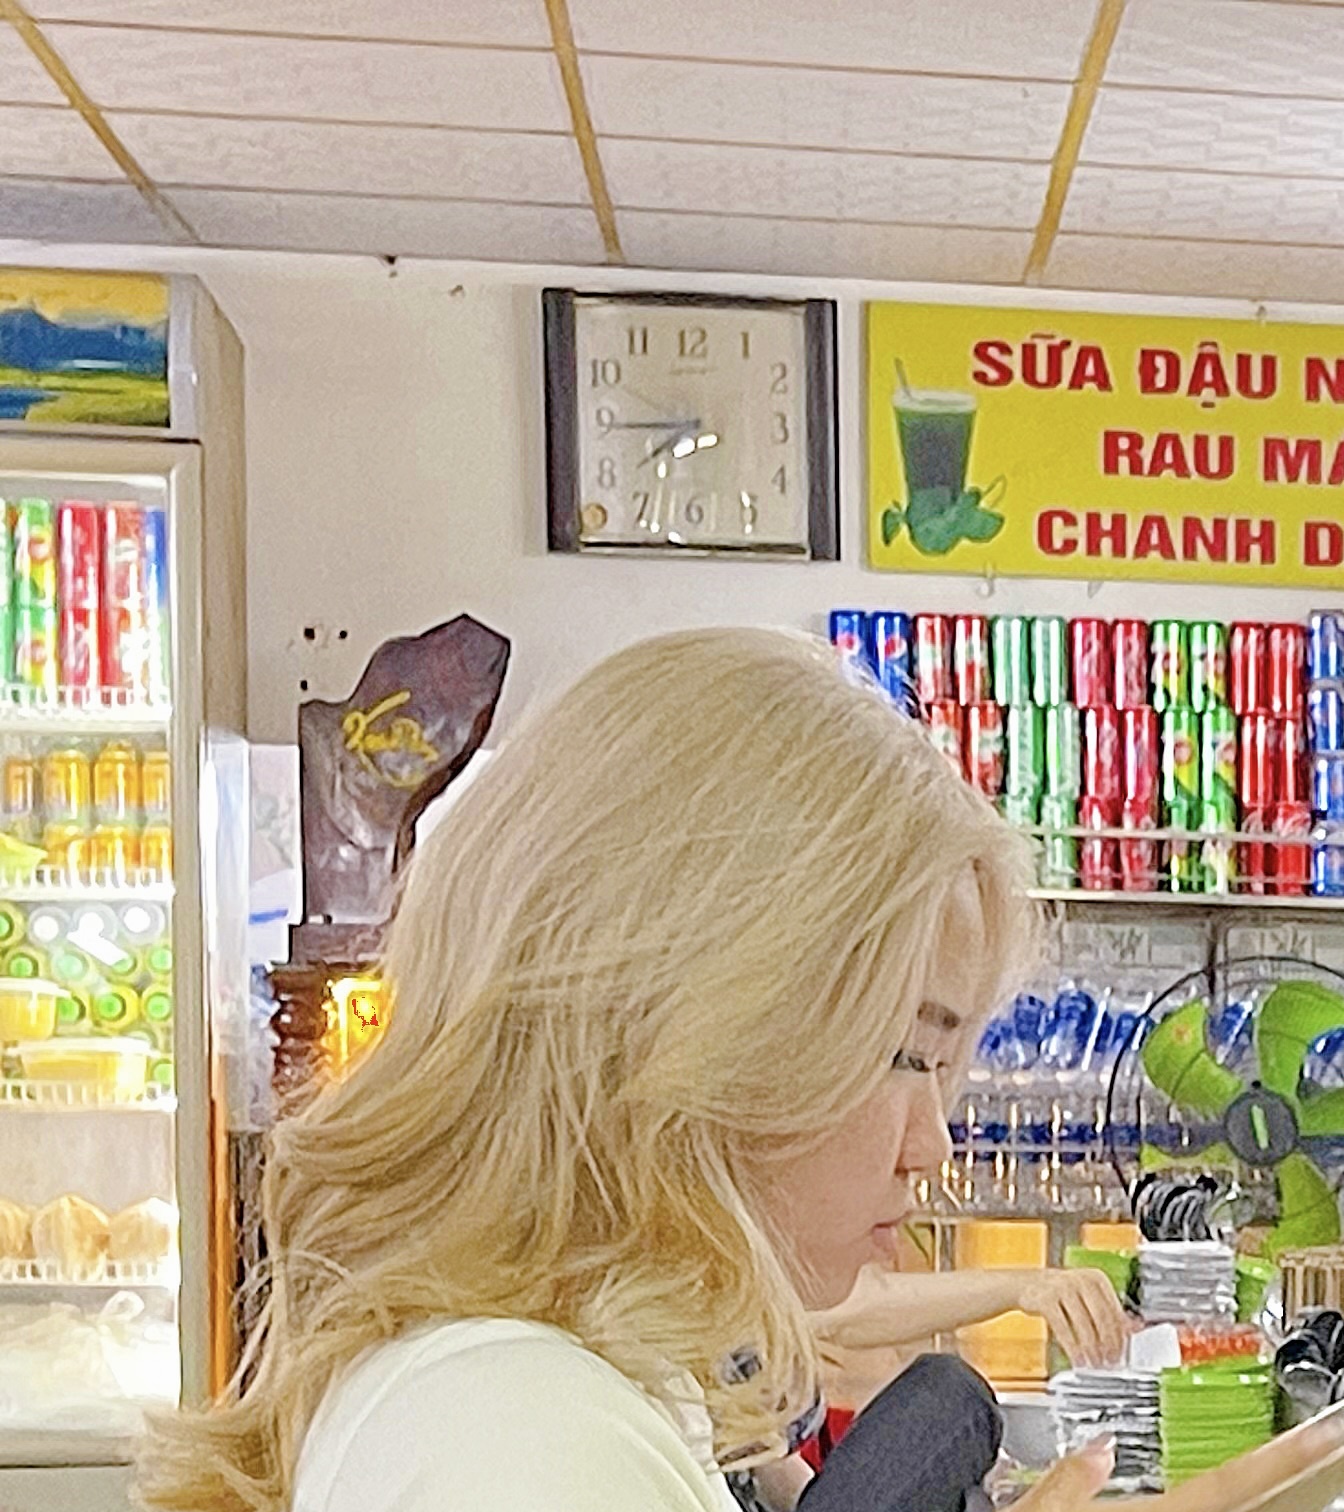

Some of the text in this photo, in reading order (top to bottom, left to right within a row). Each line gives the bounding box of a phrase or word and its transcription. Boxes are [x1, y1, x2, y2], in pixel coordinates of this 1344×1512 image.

[628, 326, 648, 356] 11
[678, 327, 708, 358] 12
[741, 331, 750, 360] 1
[591, 358, 621, 387] 10
[770, 362, 788, 395] 2
[972, 333, 1113, 392] SỮA
[1139, 341, 1278, 409] ĐẬU
[596, 407, 614, 435] 9
[772, 412, 789, 444] 3
[1103, 430, 1236, 480] RAU
[598, 457, 615, 490] 8
[771, 464, 786, 494] 4
[633, 491, 649, 524] 7
[685, 497, 704, 525] 6
[1037, 509, 1276, 563] CHANH
